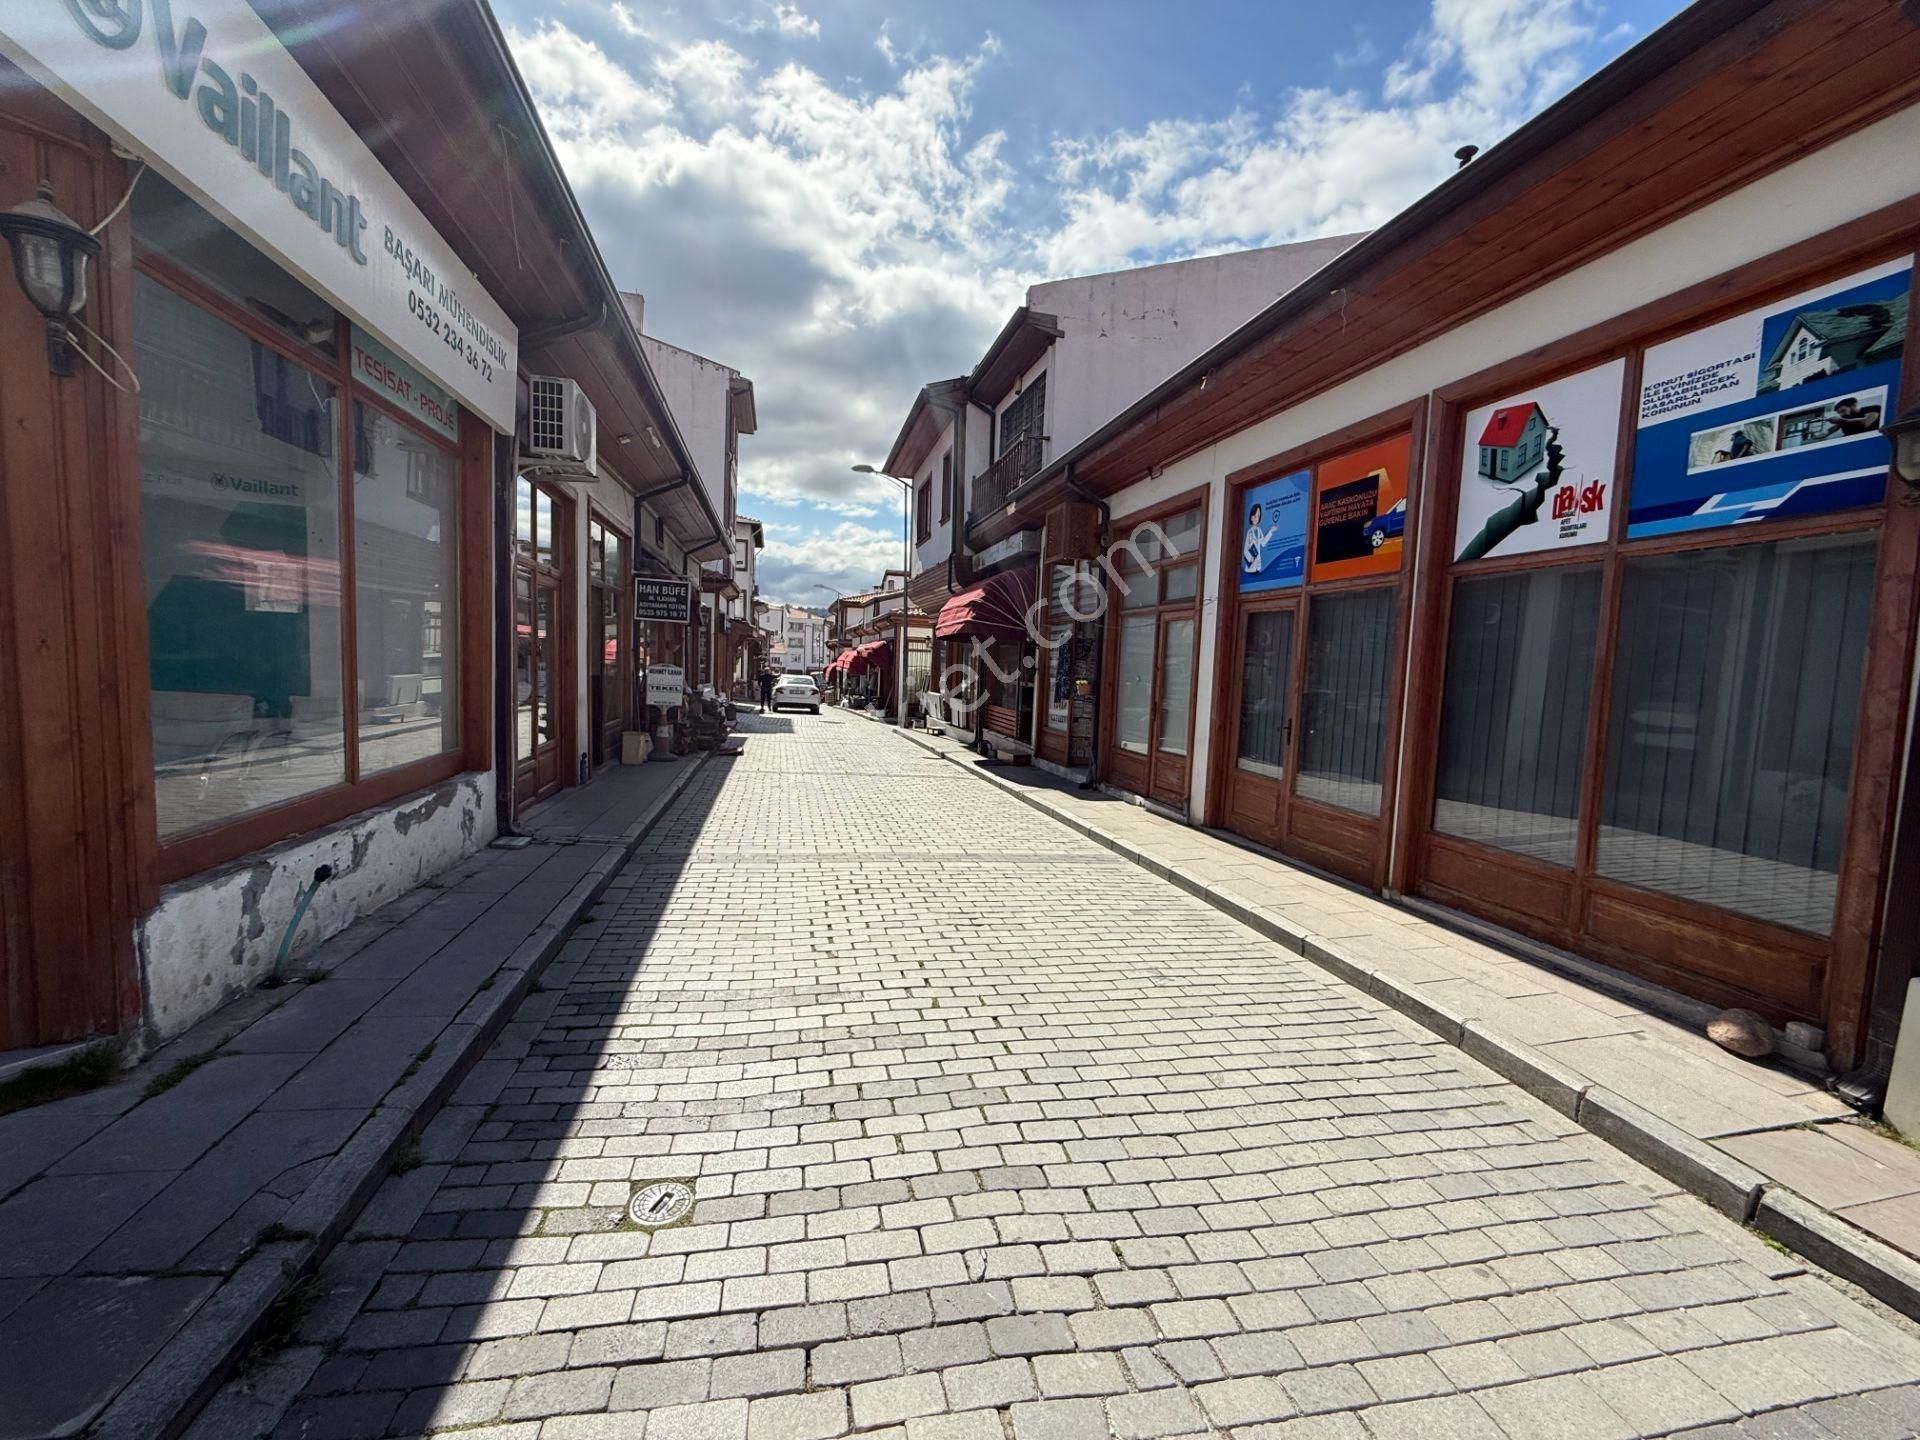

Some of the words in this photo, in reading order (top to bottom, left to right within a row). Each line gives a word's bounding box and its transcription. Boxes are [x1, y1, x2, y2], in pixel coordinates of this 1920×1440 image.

[152, 0, 367, 266] Vaillant
[384, 225, 436, 297] BAŞARI
[438, 283, 508, 370] MÜHENDİSLİK
[408, 289, 440, 336] 0532
[443, 322, 465, 357] 234
[466, 344, 479, 371] 36
[481, 358, 493, 384] 72
[354, 345, 412, 400] TESİSAT
[420, 391, 454, 431] PROJE
[1643, 388, 1661, 400] İLE
[1662, 370, 1720, 395] EVİNİZDE
[1644, 374, 1685, 393] KONUT
[1686, 352, 1756, 379] SİGORTASI
[1641, 379, 1740, 413] HASARLARDAN
[1641, 398, 1702, 419] KORUNUN
[229, 476, 300, 497] Vaillant
[1552, 479, 1606, 520] dask
[639, 584, 660, 594] HAN
[662, 584, 687, 596] BÜFE
